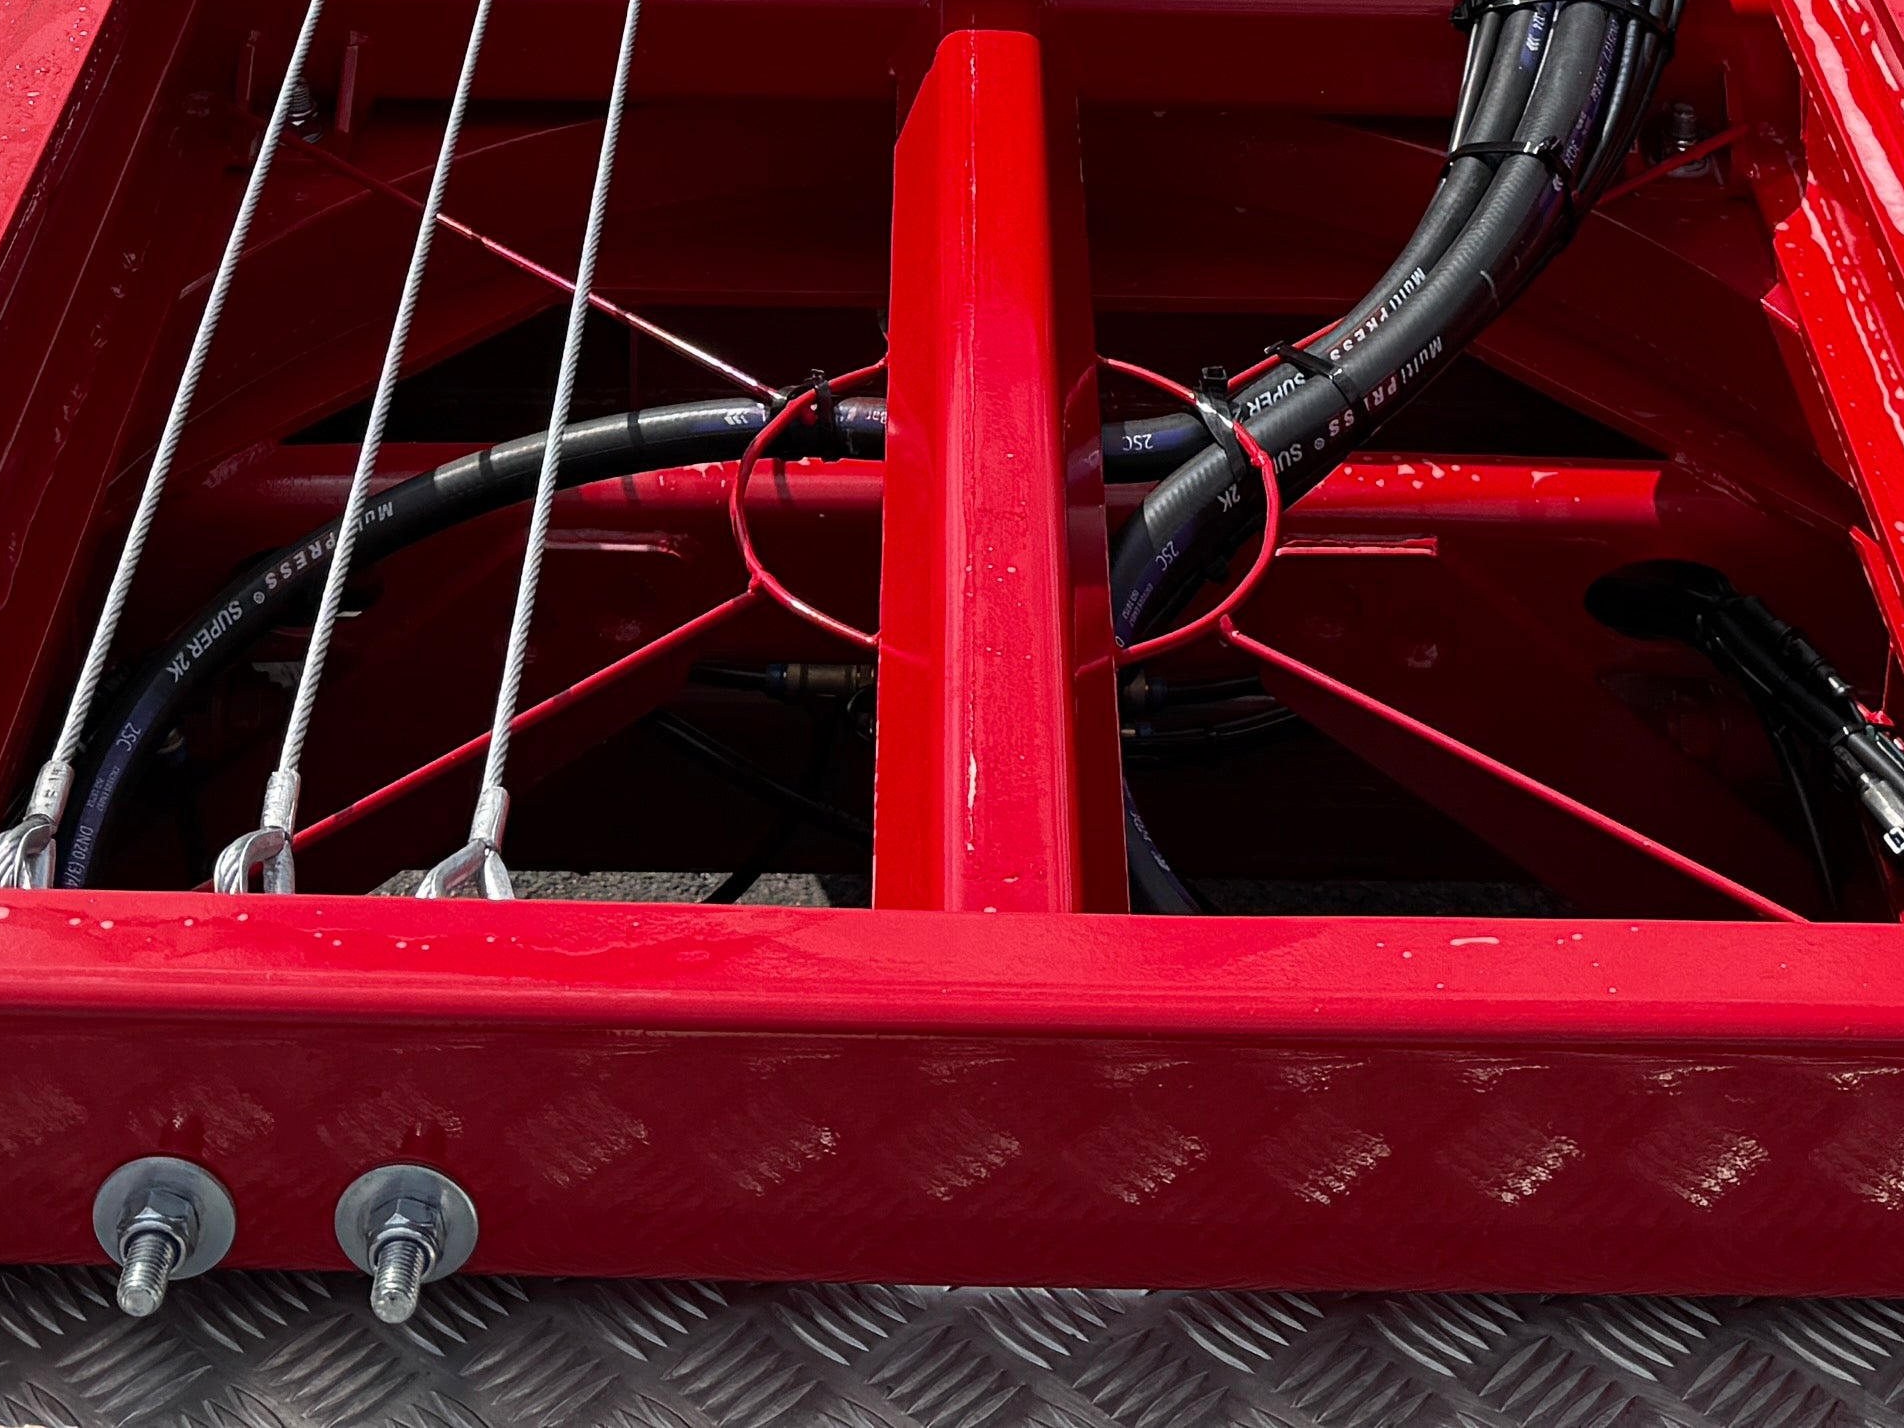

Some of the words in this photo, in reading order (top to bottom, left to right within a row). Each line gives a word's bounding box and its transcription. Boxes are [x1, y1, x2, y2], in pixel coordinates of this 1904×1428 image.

[1122, 433, 1153, 452] 2SC
[1217, 483, 1241, 513] 2K
[1156, 540, 1180, 572] 2SC
[186, 600, 243, 659] SUPER
[165, 650, 192, 683] 2K
[115, 722, 142, 752] 2SC
[73, 824, 95, 861] DN20
